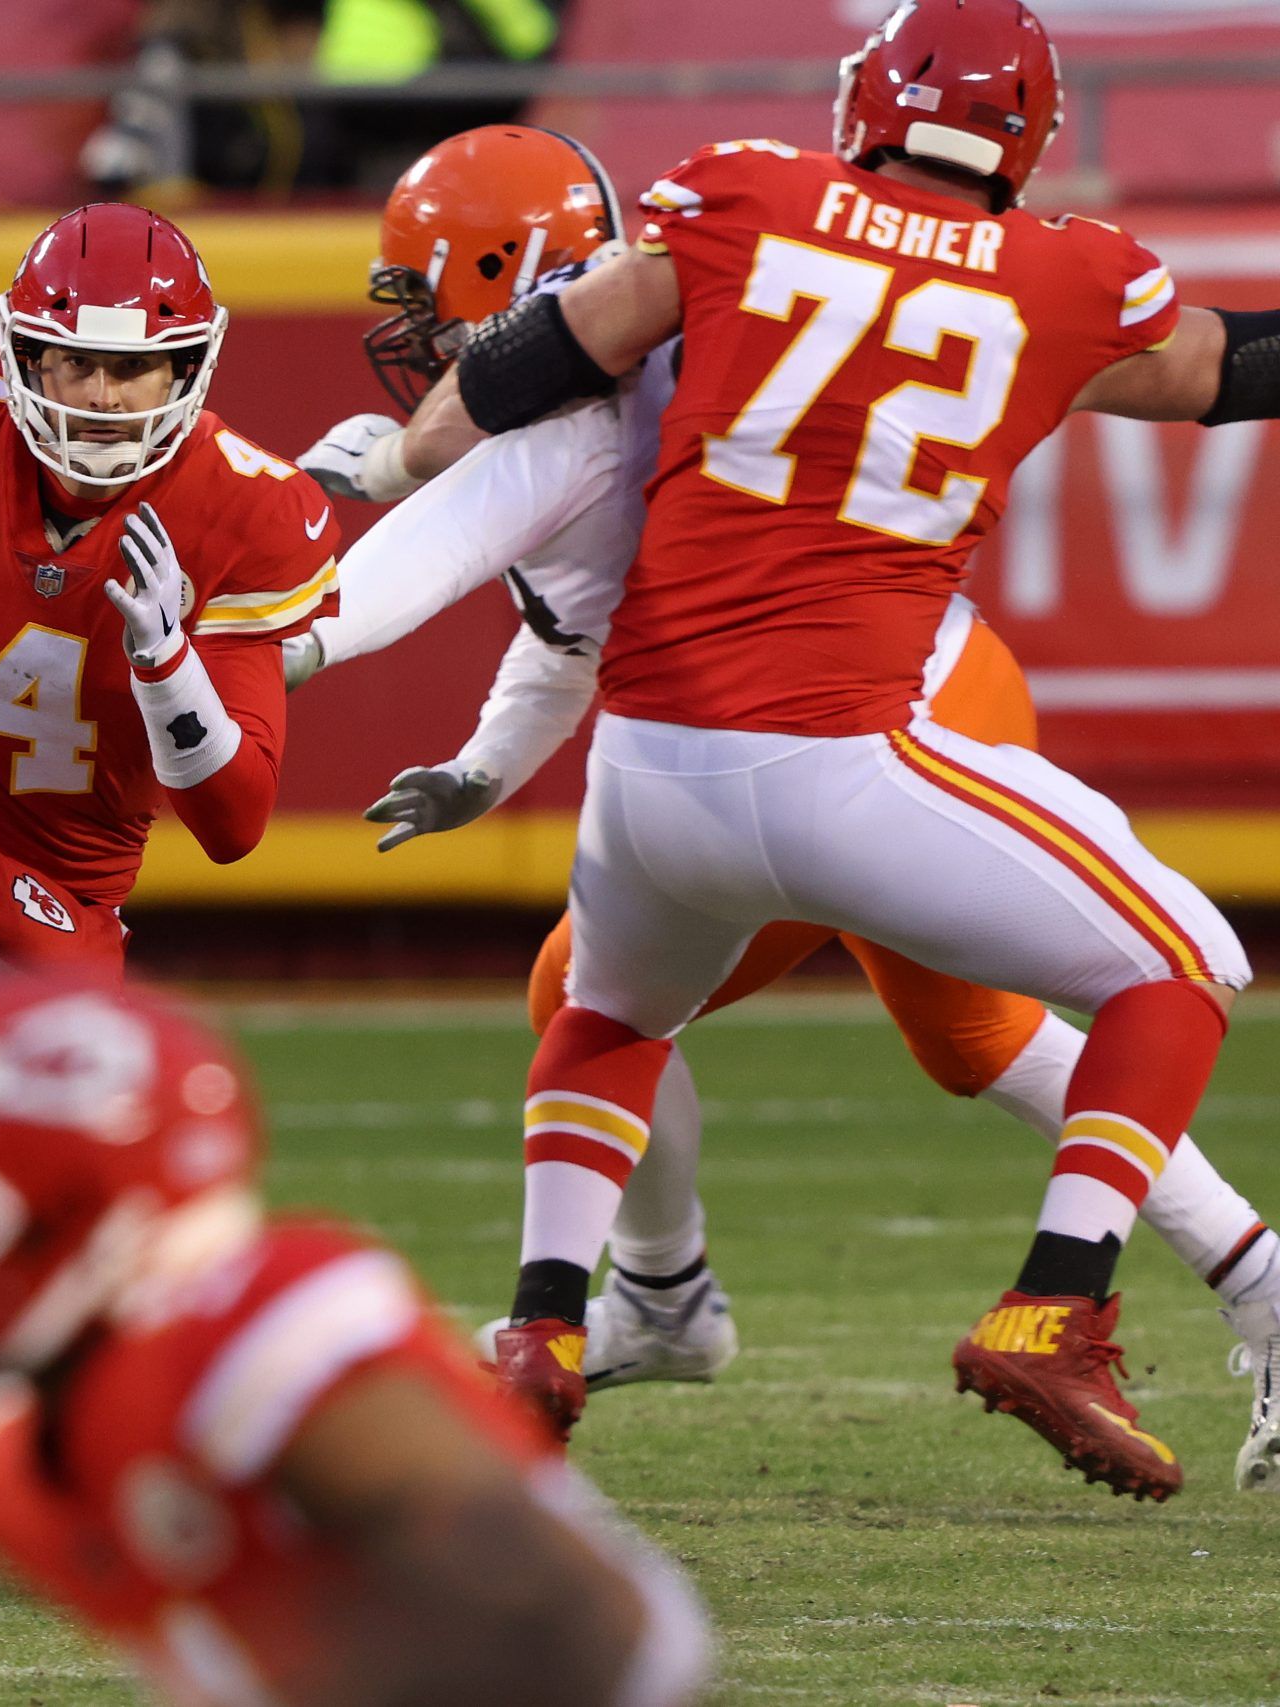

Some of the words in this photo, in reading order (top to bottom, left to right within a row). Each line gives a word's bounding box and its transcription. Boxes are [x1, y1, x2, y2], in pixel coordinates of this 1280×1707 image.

[813, 181, 1005, 273] FISHER
[699, 232, 1030, 546] 72
[214, 429, 299, 481] 4
[970, 1305, 1071, 1354] NIKE
